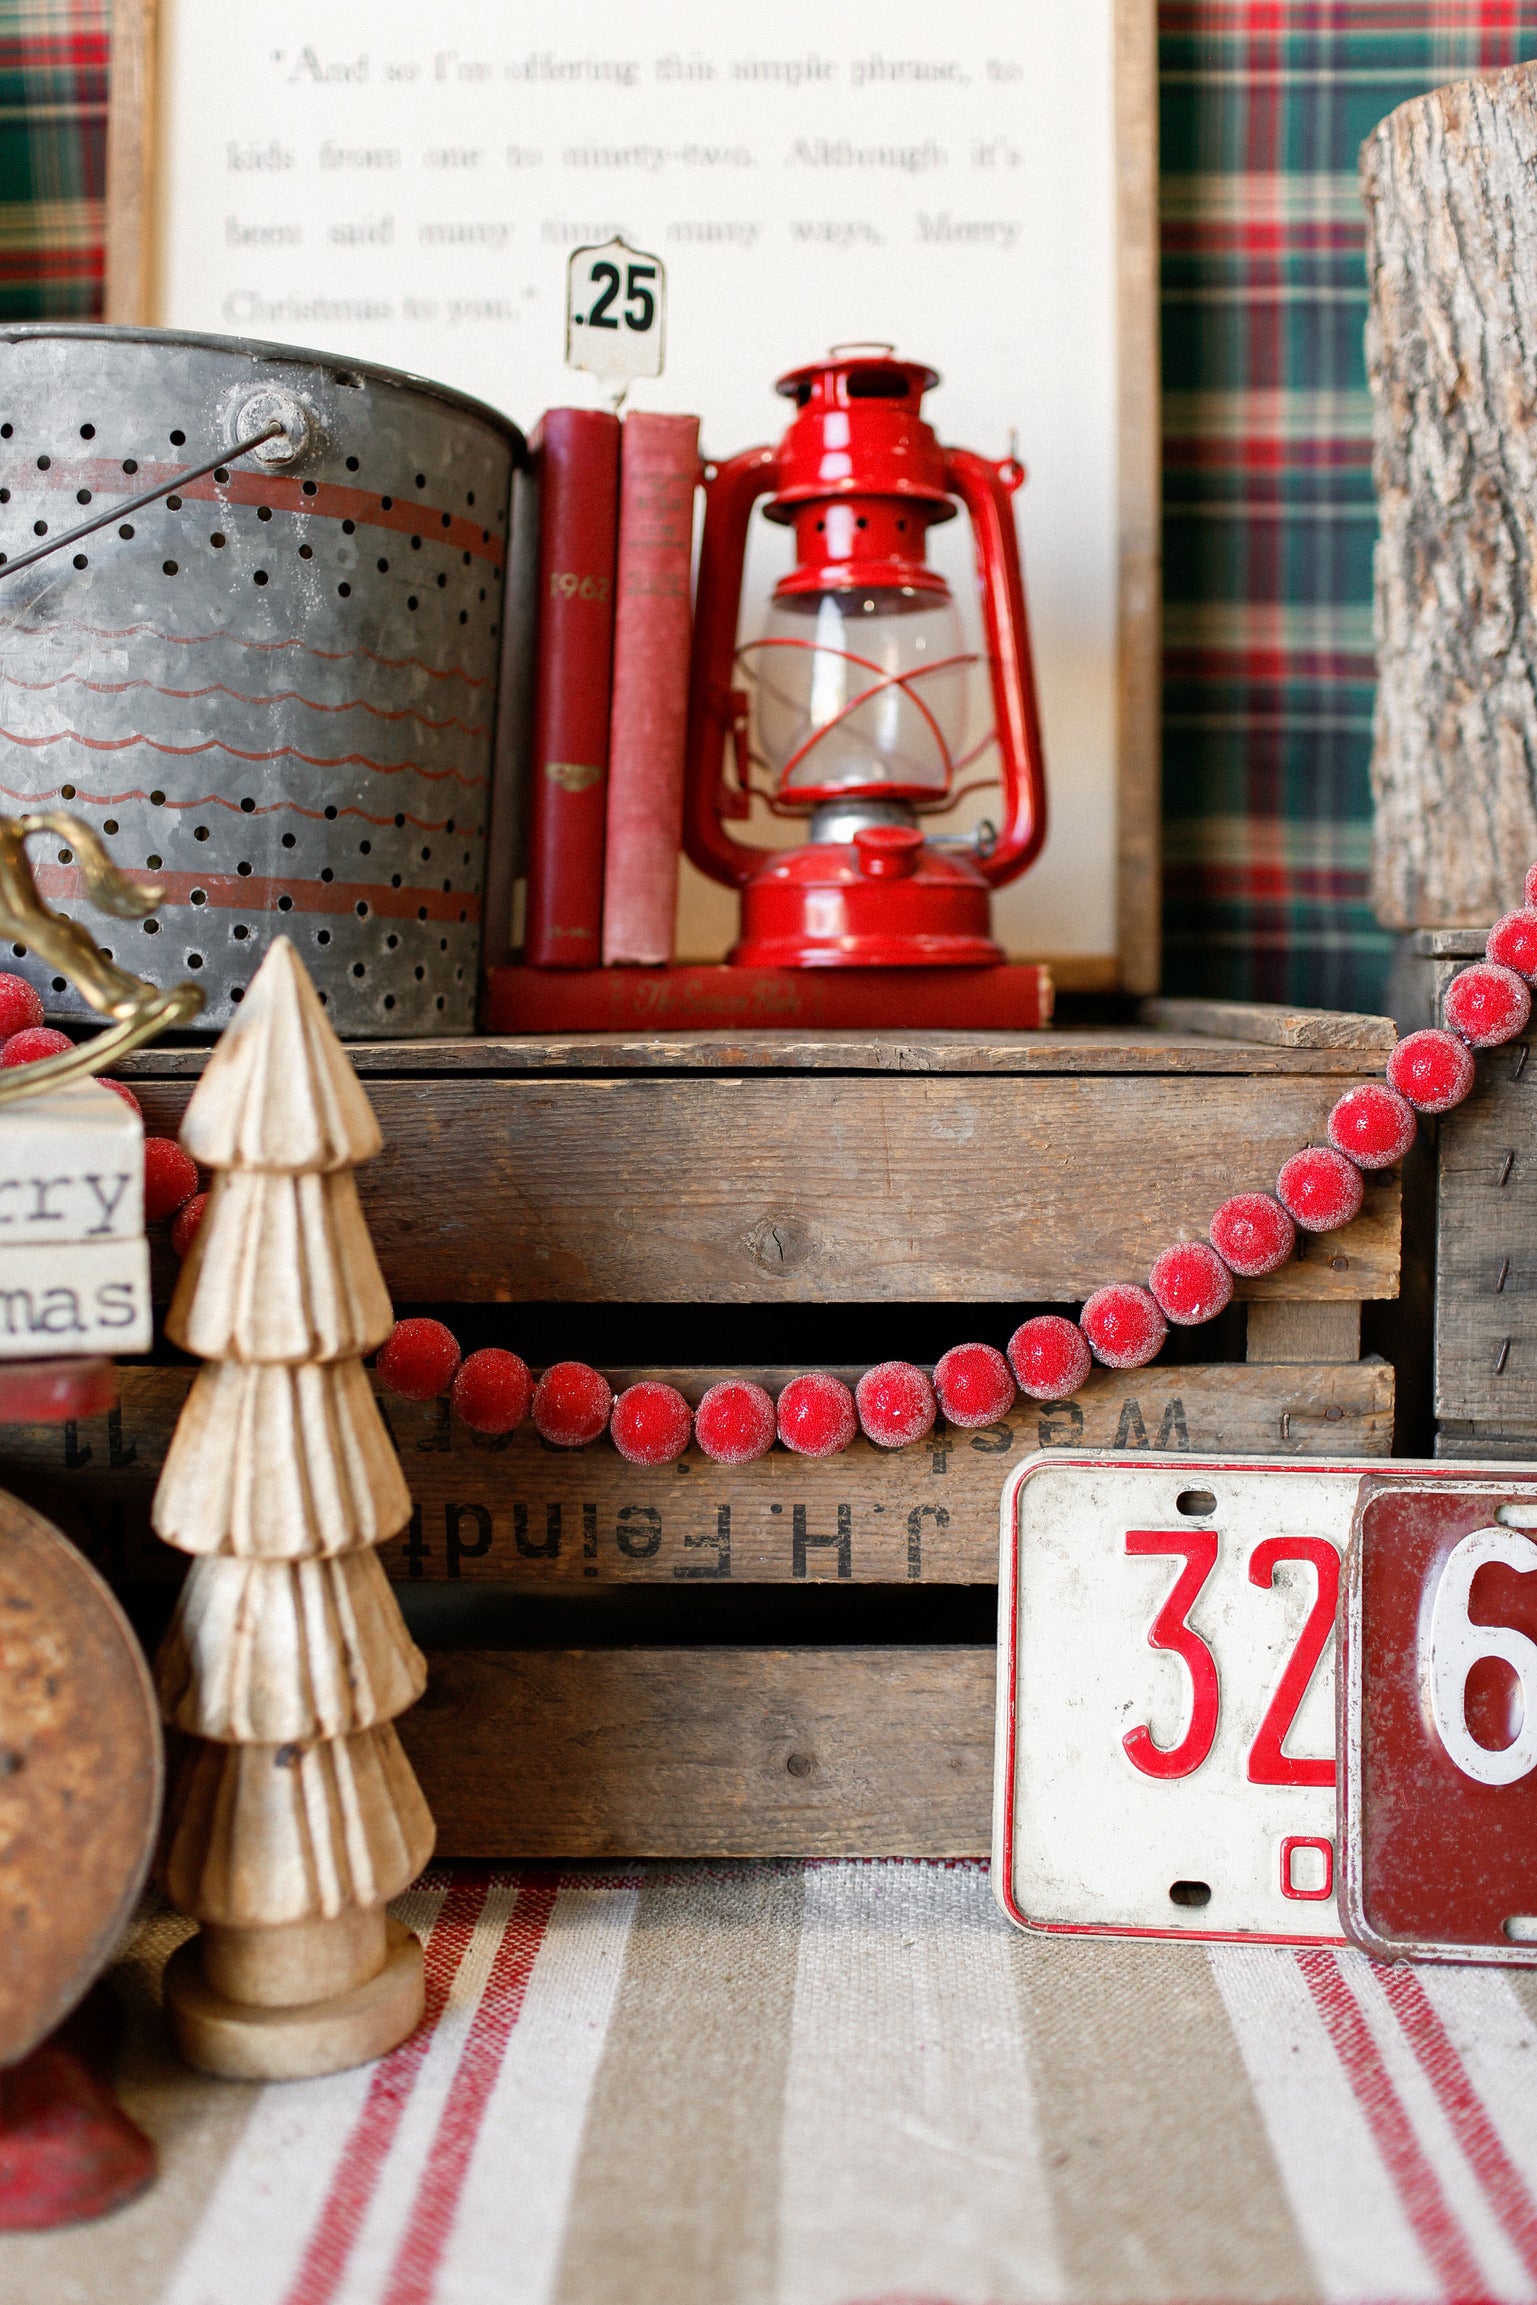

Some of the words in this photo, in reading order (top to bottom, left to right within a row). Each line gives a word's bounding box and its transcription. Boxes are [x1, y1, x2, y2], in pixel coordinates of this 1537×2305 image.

[382, 60, 420, 83] so
[434, 50, 493, 83] I'm
[504, 51, 640, 87] offering
[655, 52, 716, 82] this
[730, 51, 838, 87] simple
[850, 52, 972, 87] phrase,
[985, 57, 1024, 83] to
[225, 139, 296, 171] kids
[318, 139, 402, 171] from
[422, 146, 483, 169] one
[505, 142, 543, 169] to
[786, 136, 949, 174] Although
[969, 134, 1024, 168] it's
[225, 213, 302, 248] been
[330, 213, 395, 247] said
[417, 222, 514, 250] many
[668, 220, 762, 250] many
[791, 220, 888, 250] ways,
[913, 209, 1021, 250] Merry
[221, 288, 393, 324] Christmas
[402, 297, 439, 321] to
[573, 260, 659, 333] .25
[1122, 1529, 1342, 1787] 32
[1430, 1526, 1537, 1786] 6
